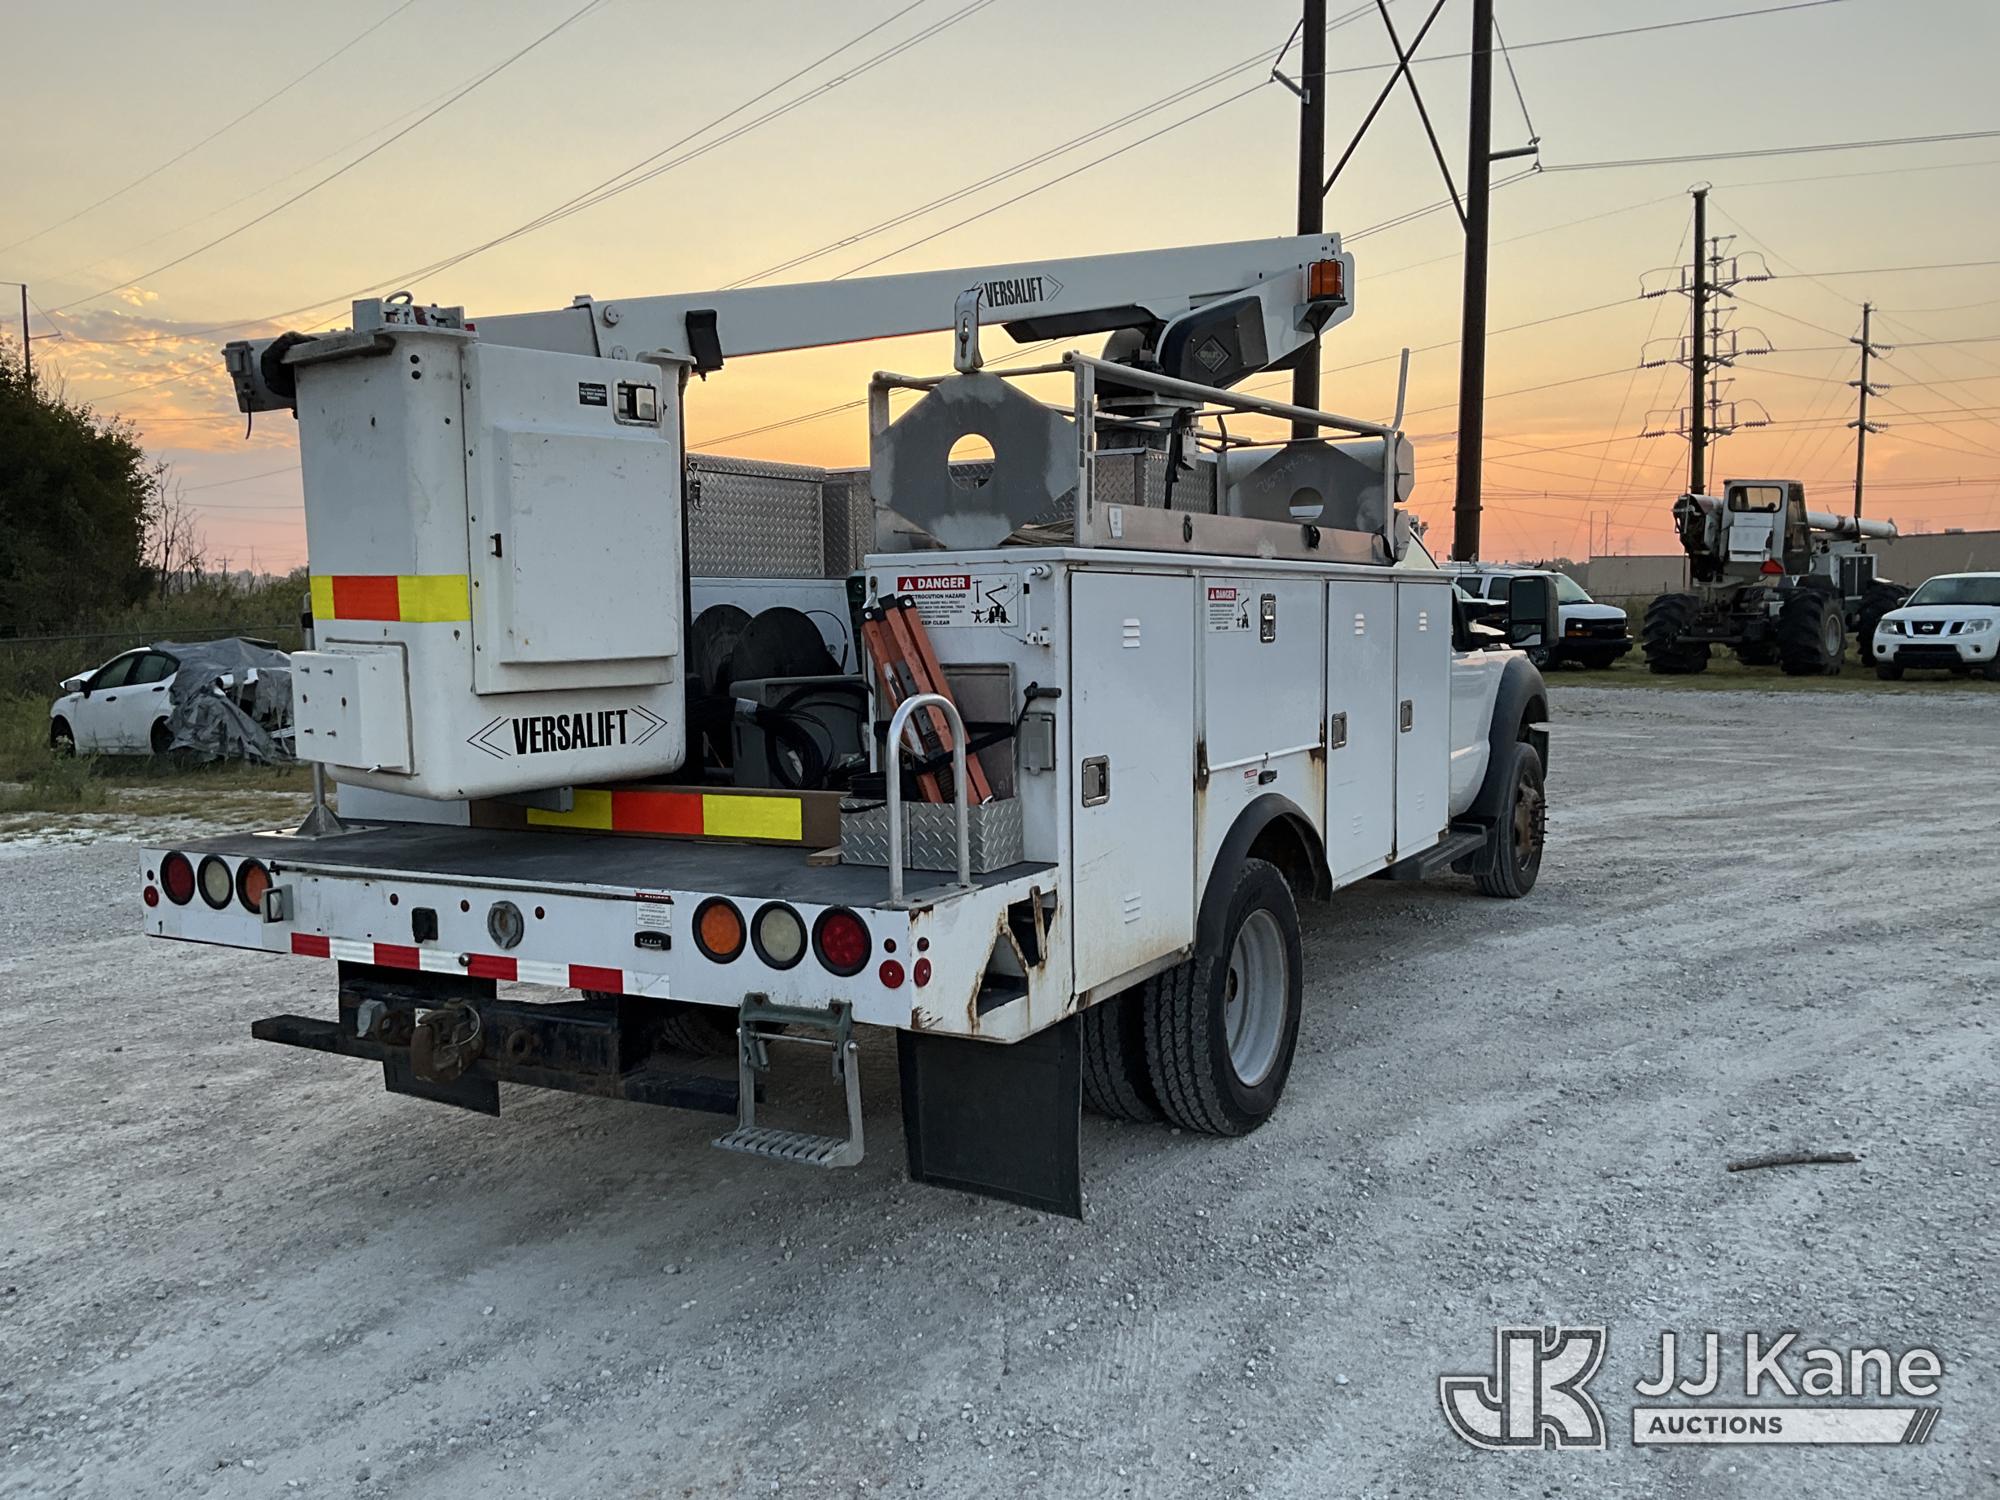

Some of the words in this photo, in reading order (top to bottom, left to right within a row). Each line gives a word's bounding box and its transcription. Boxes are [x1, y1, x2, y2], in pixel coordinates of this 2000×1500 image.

[984, 276, 1044, 308] VERSALIFT
[917, 577, 966, 589] DANGER
[512, 708, 629, 755] VERSALIFT
